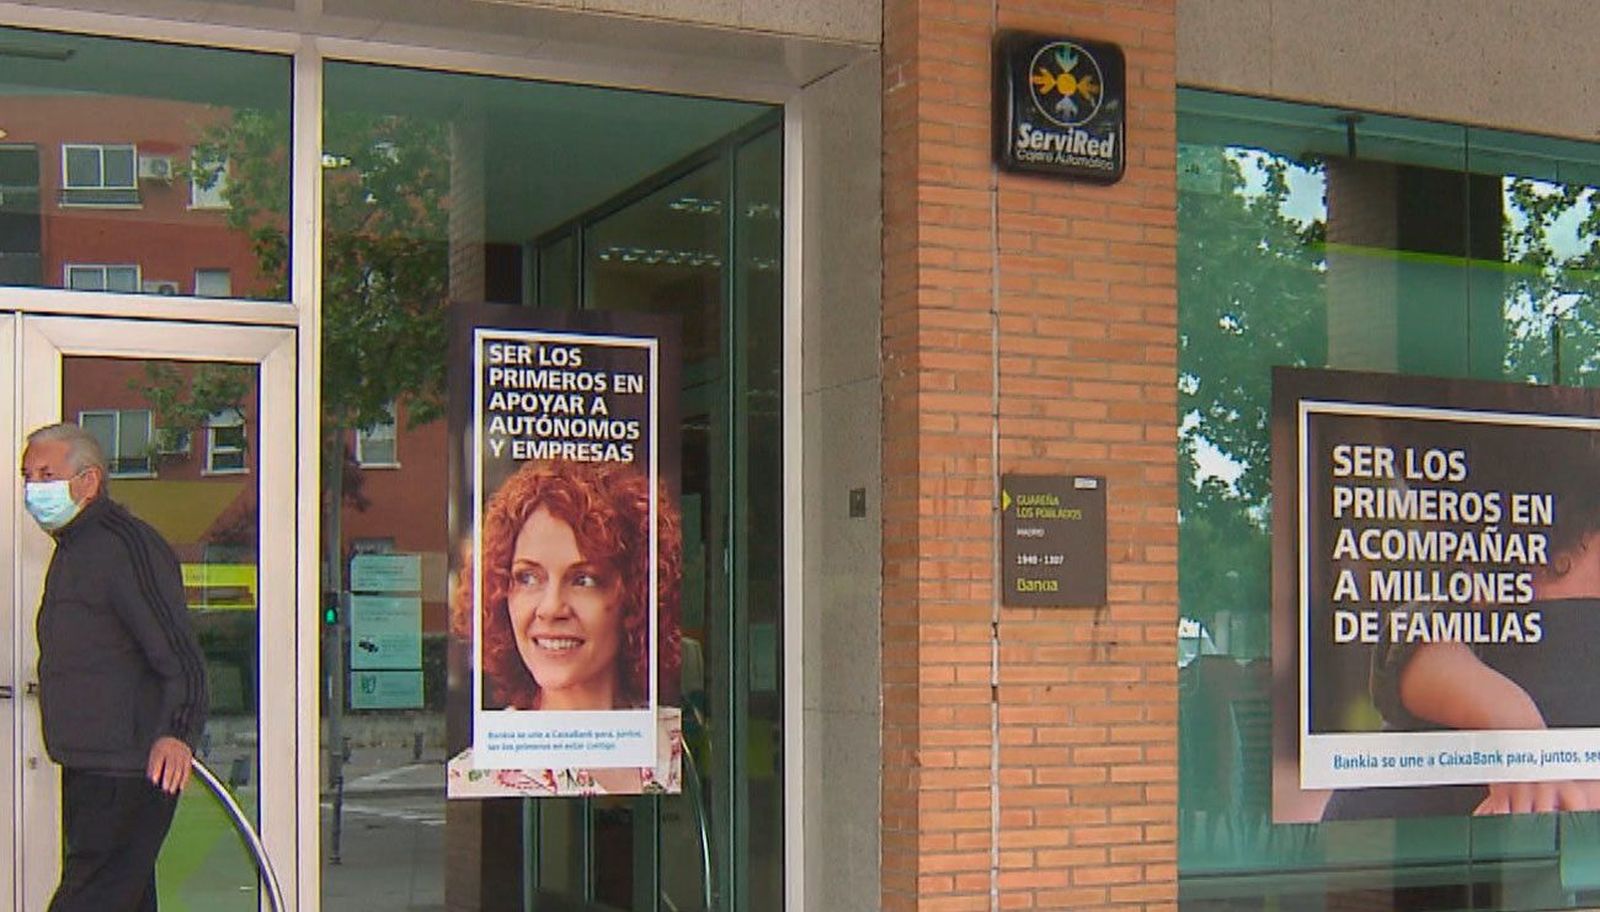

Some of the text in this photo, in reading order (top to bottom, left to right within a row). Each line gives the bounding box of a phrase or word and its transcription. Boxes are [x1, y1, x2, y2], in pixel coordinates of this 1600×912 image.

[1016, 122, 1115, 158] ServiRed
[488, 344, 582, 366] SER LOS
[489, 368, 644, 394] PRIMEROS EN
[489, 392, 608, 415] APOYAR A
[489, 415, 640, 440] AUTÓNOMOS
[489, 438, 634, 463] Y EMPRESAS
[1333, 445, 1468, 482] SER LOS
[1333, 486, 1554, 525] PRIMEROS EN
[1333, 526, 1548, 564] ACOMPAÑAR
[1333, 569, 1533, 604] A MILLONES
[1334, 611, 1542, 644] DE FAMILIAS
[1333, 754, 1378, 769] Bankia
[1400, 756, 1424, 767] une
[1427, 756, 1435, 766] a
[1438, 750, 1503, 766] CaixaBank
